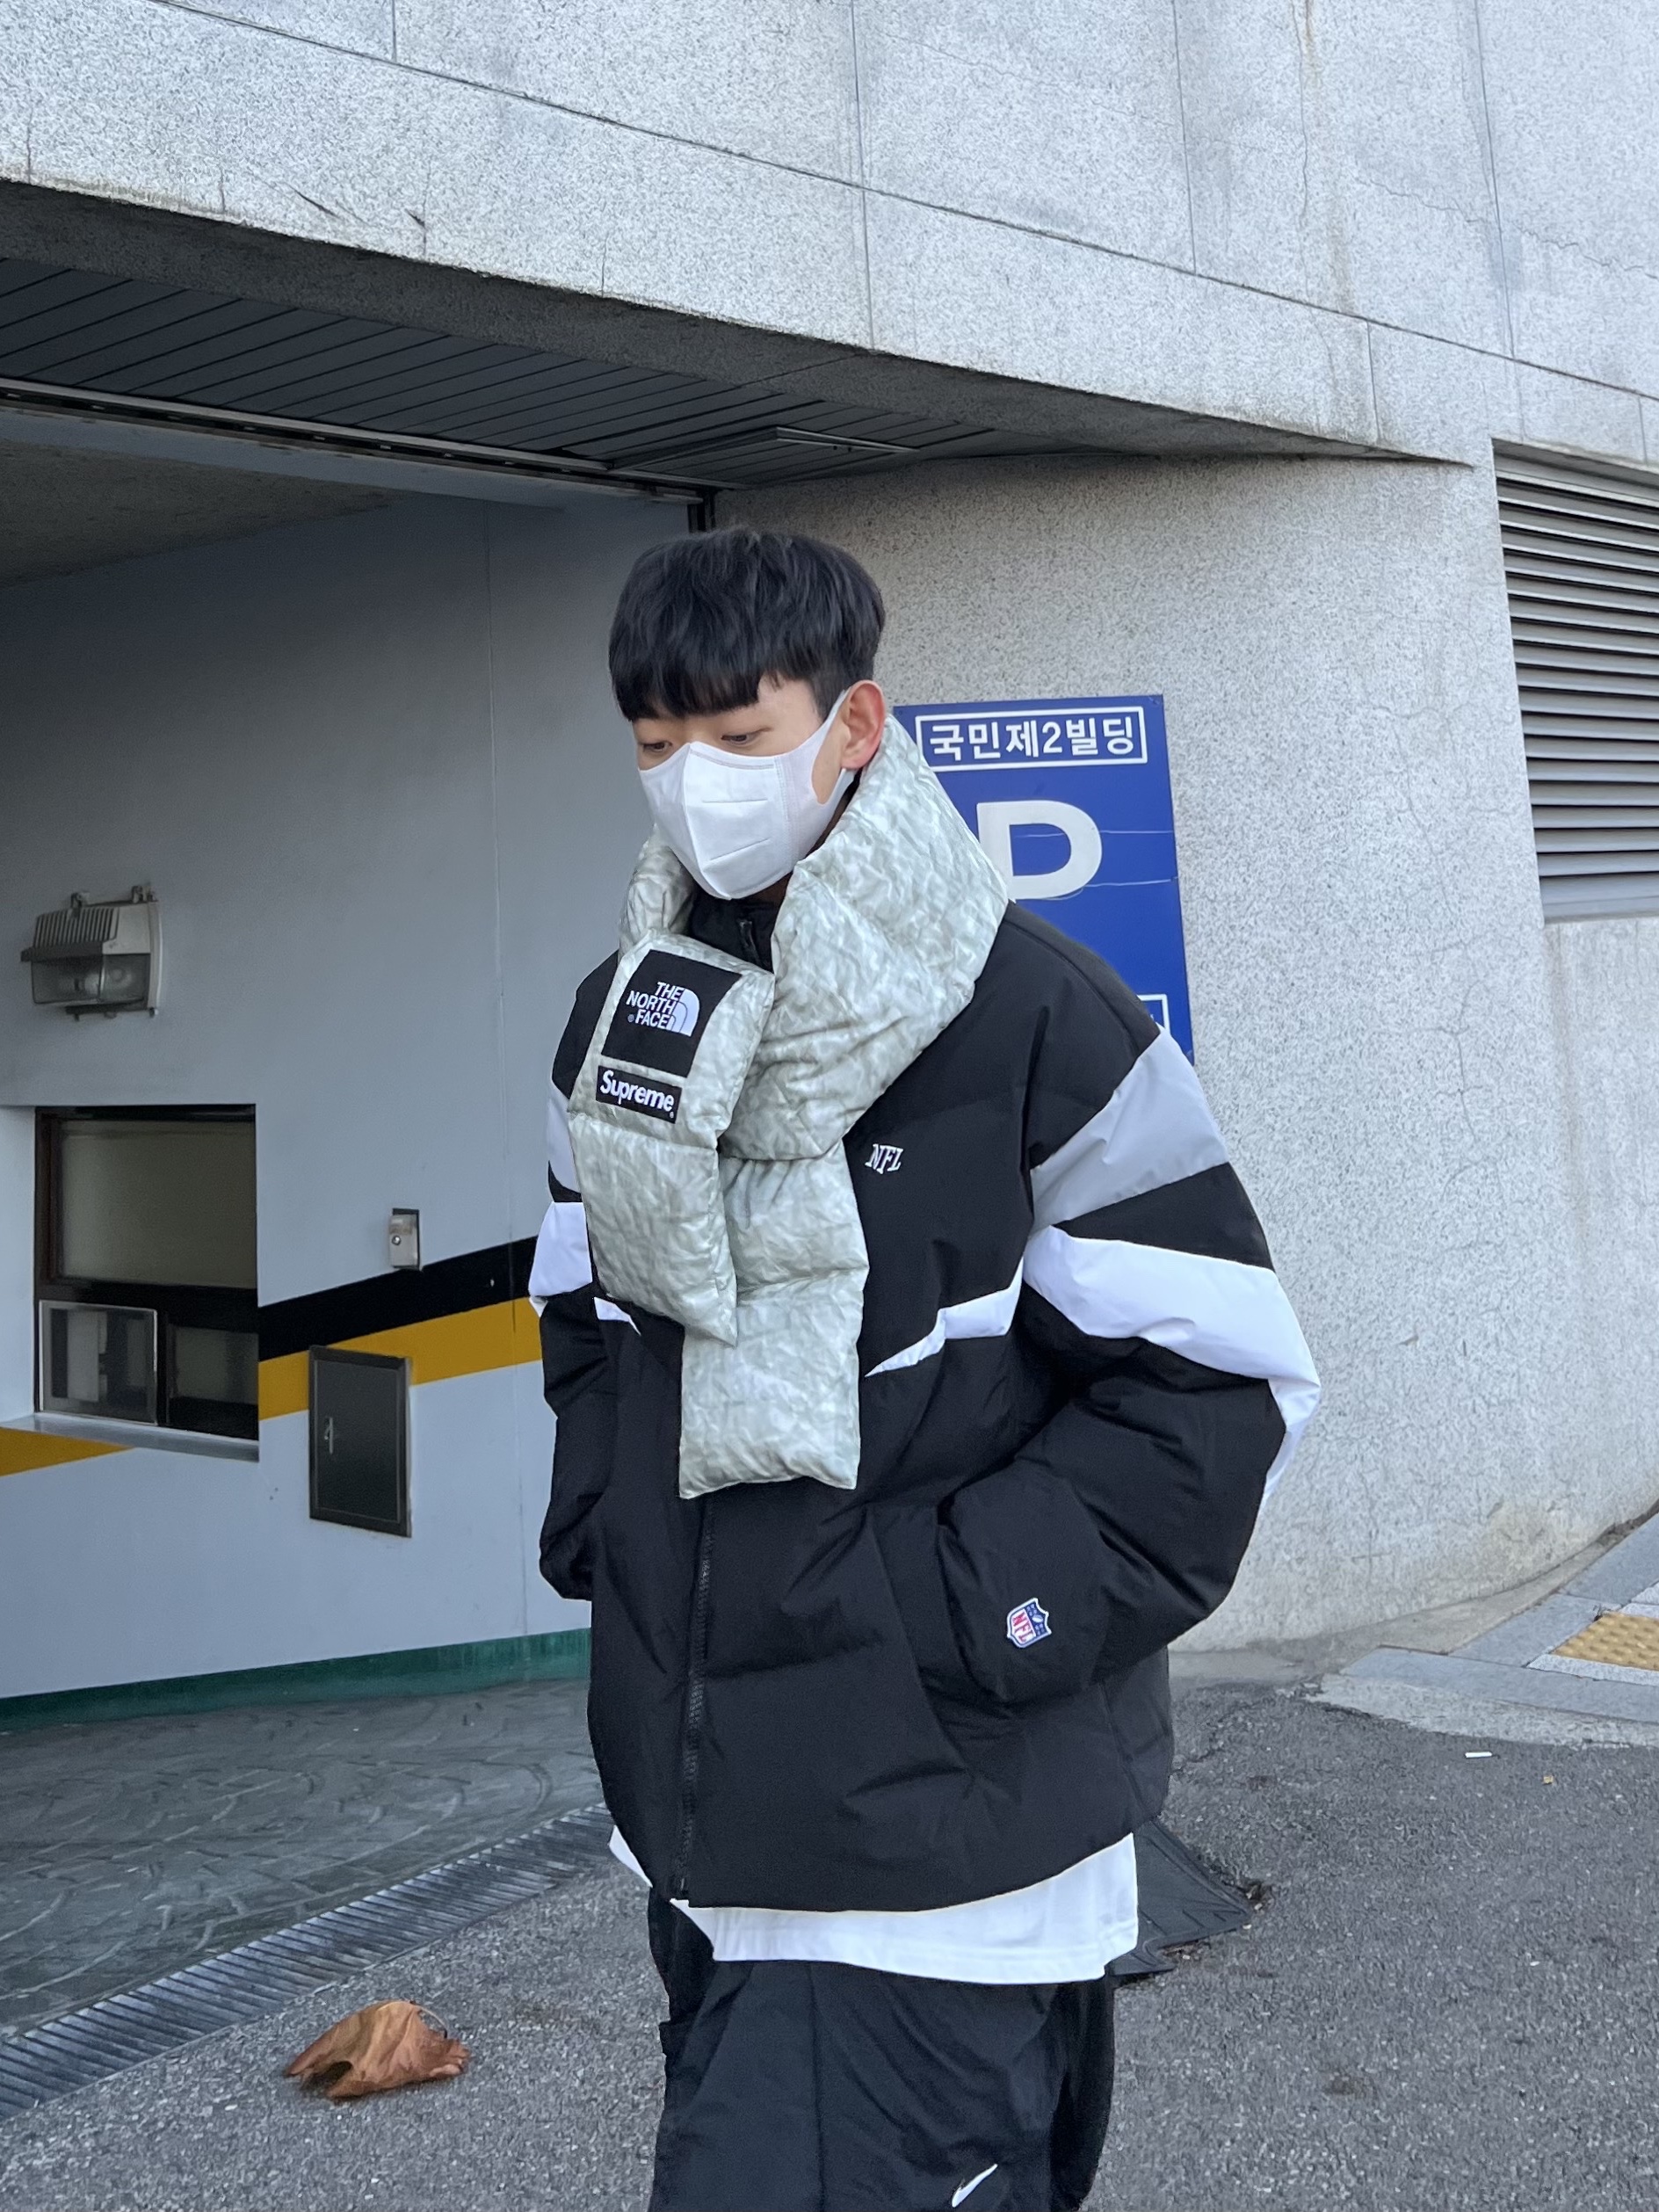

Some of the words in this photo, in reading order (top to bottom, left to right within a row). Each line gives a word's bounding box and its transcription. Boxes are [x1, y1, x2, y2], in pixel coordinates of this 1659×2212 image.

[930, 716, 1134, 761] 국민제2빌딩
[626, 990, 677, 1015] NORTH
[655, 981, 685, 1002] THE
[634, 1008, 670, 1030] FACE
[599, 1070, 675, 1113] Supreme
[865, 1143, 904, 1175] NFL
[1012, 1611, 1034, 1643] NFL
